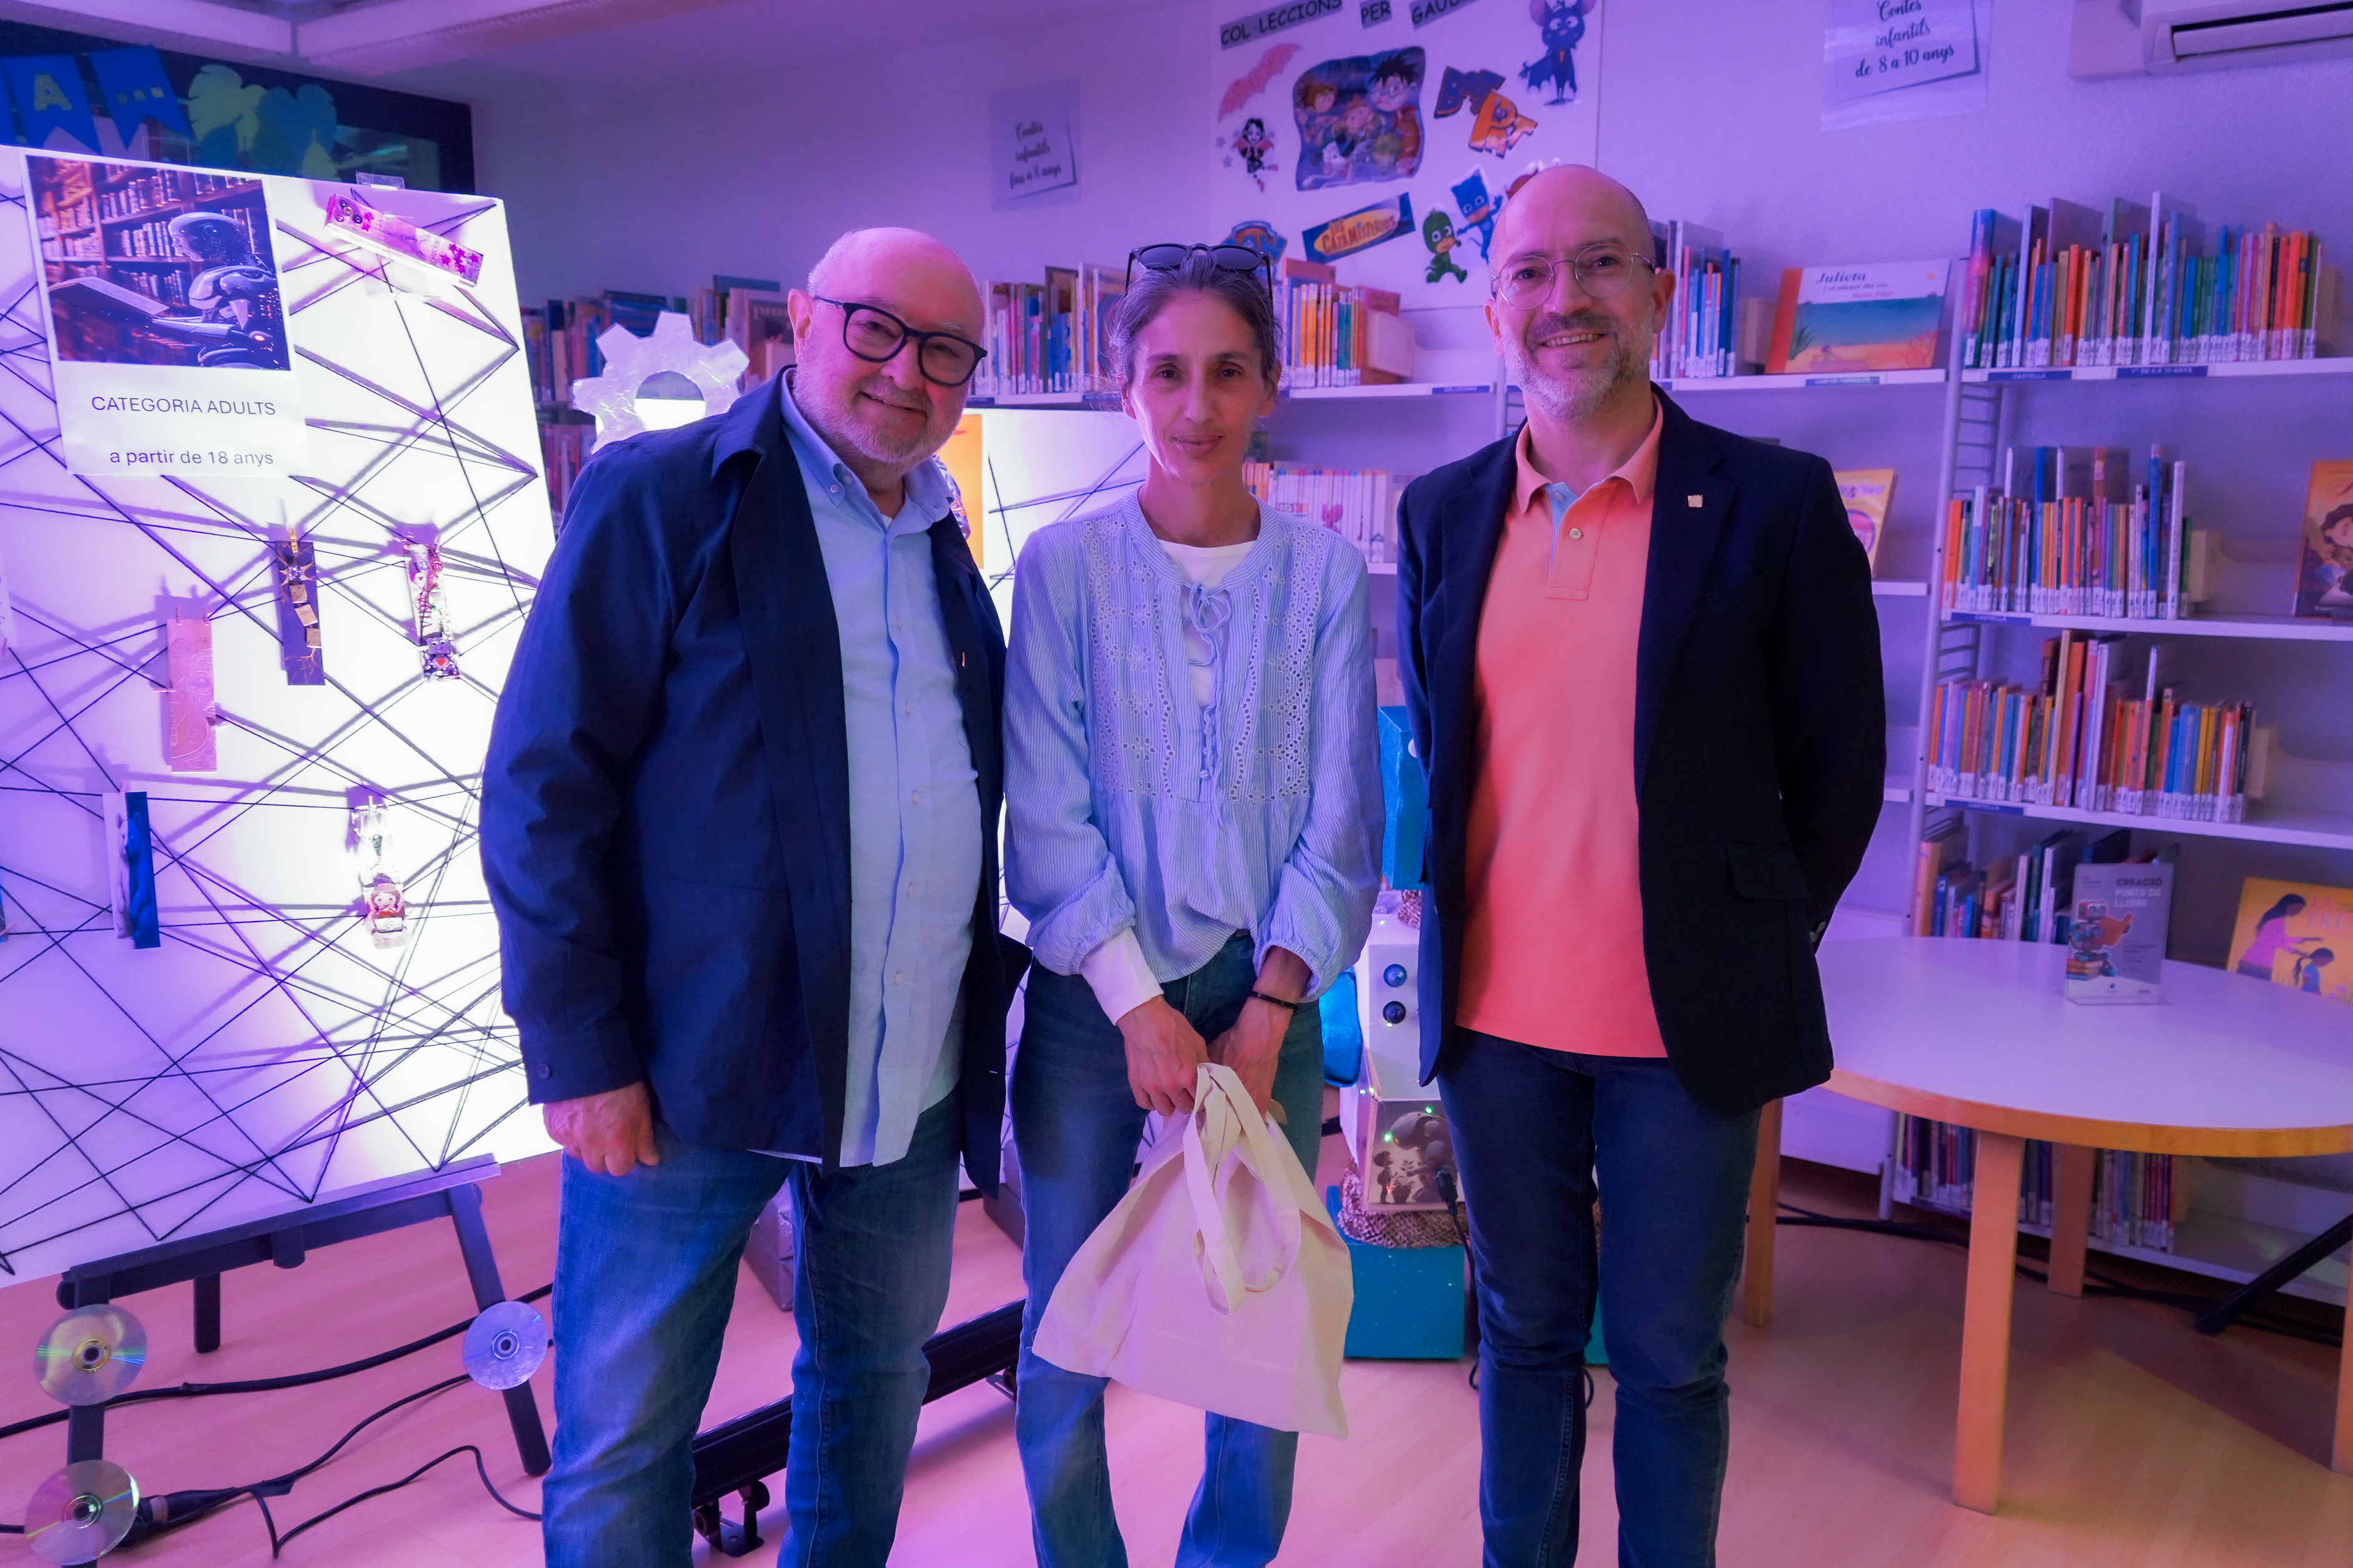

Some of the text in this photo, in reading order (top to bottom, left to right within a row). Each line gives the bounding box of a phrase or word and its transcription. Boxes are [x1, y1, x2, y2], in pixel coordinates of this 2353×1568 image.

[1360, 1, 1390, 24] PER
[1878, 0, 1921, 21] Contes
[1876, 17, 1931, 48] infantils
[1856, 44, 1954, 78] de 8 a 10 anys
[1816, 271, 1866, 284] Julieta
[92, 397, 275, 415] CATEGORIA ADULTS
[110, 450, 274, 467] a partir de 18 anys
